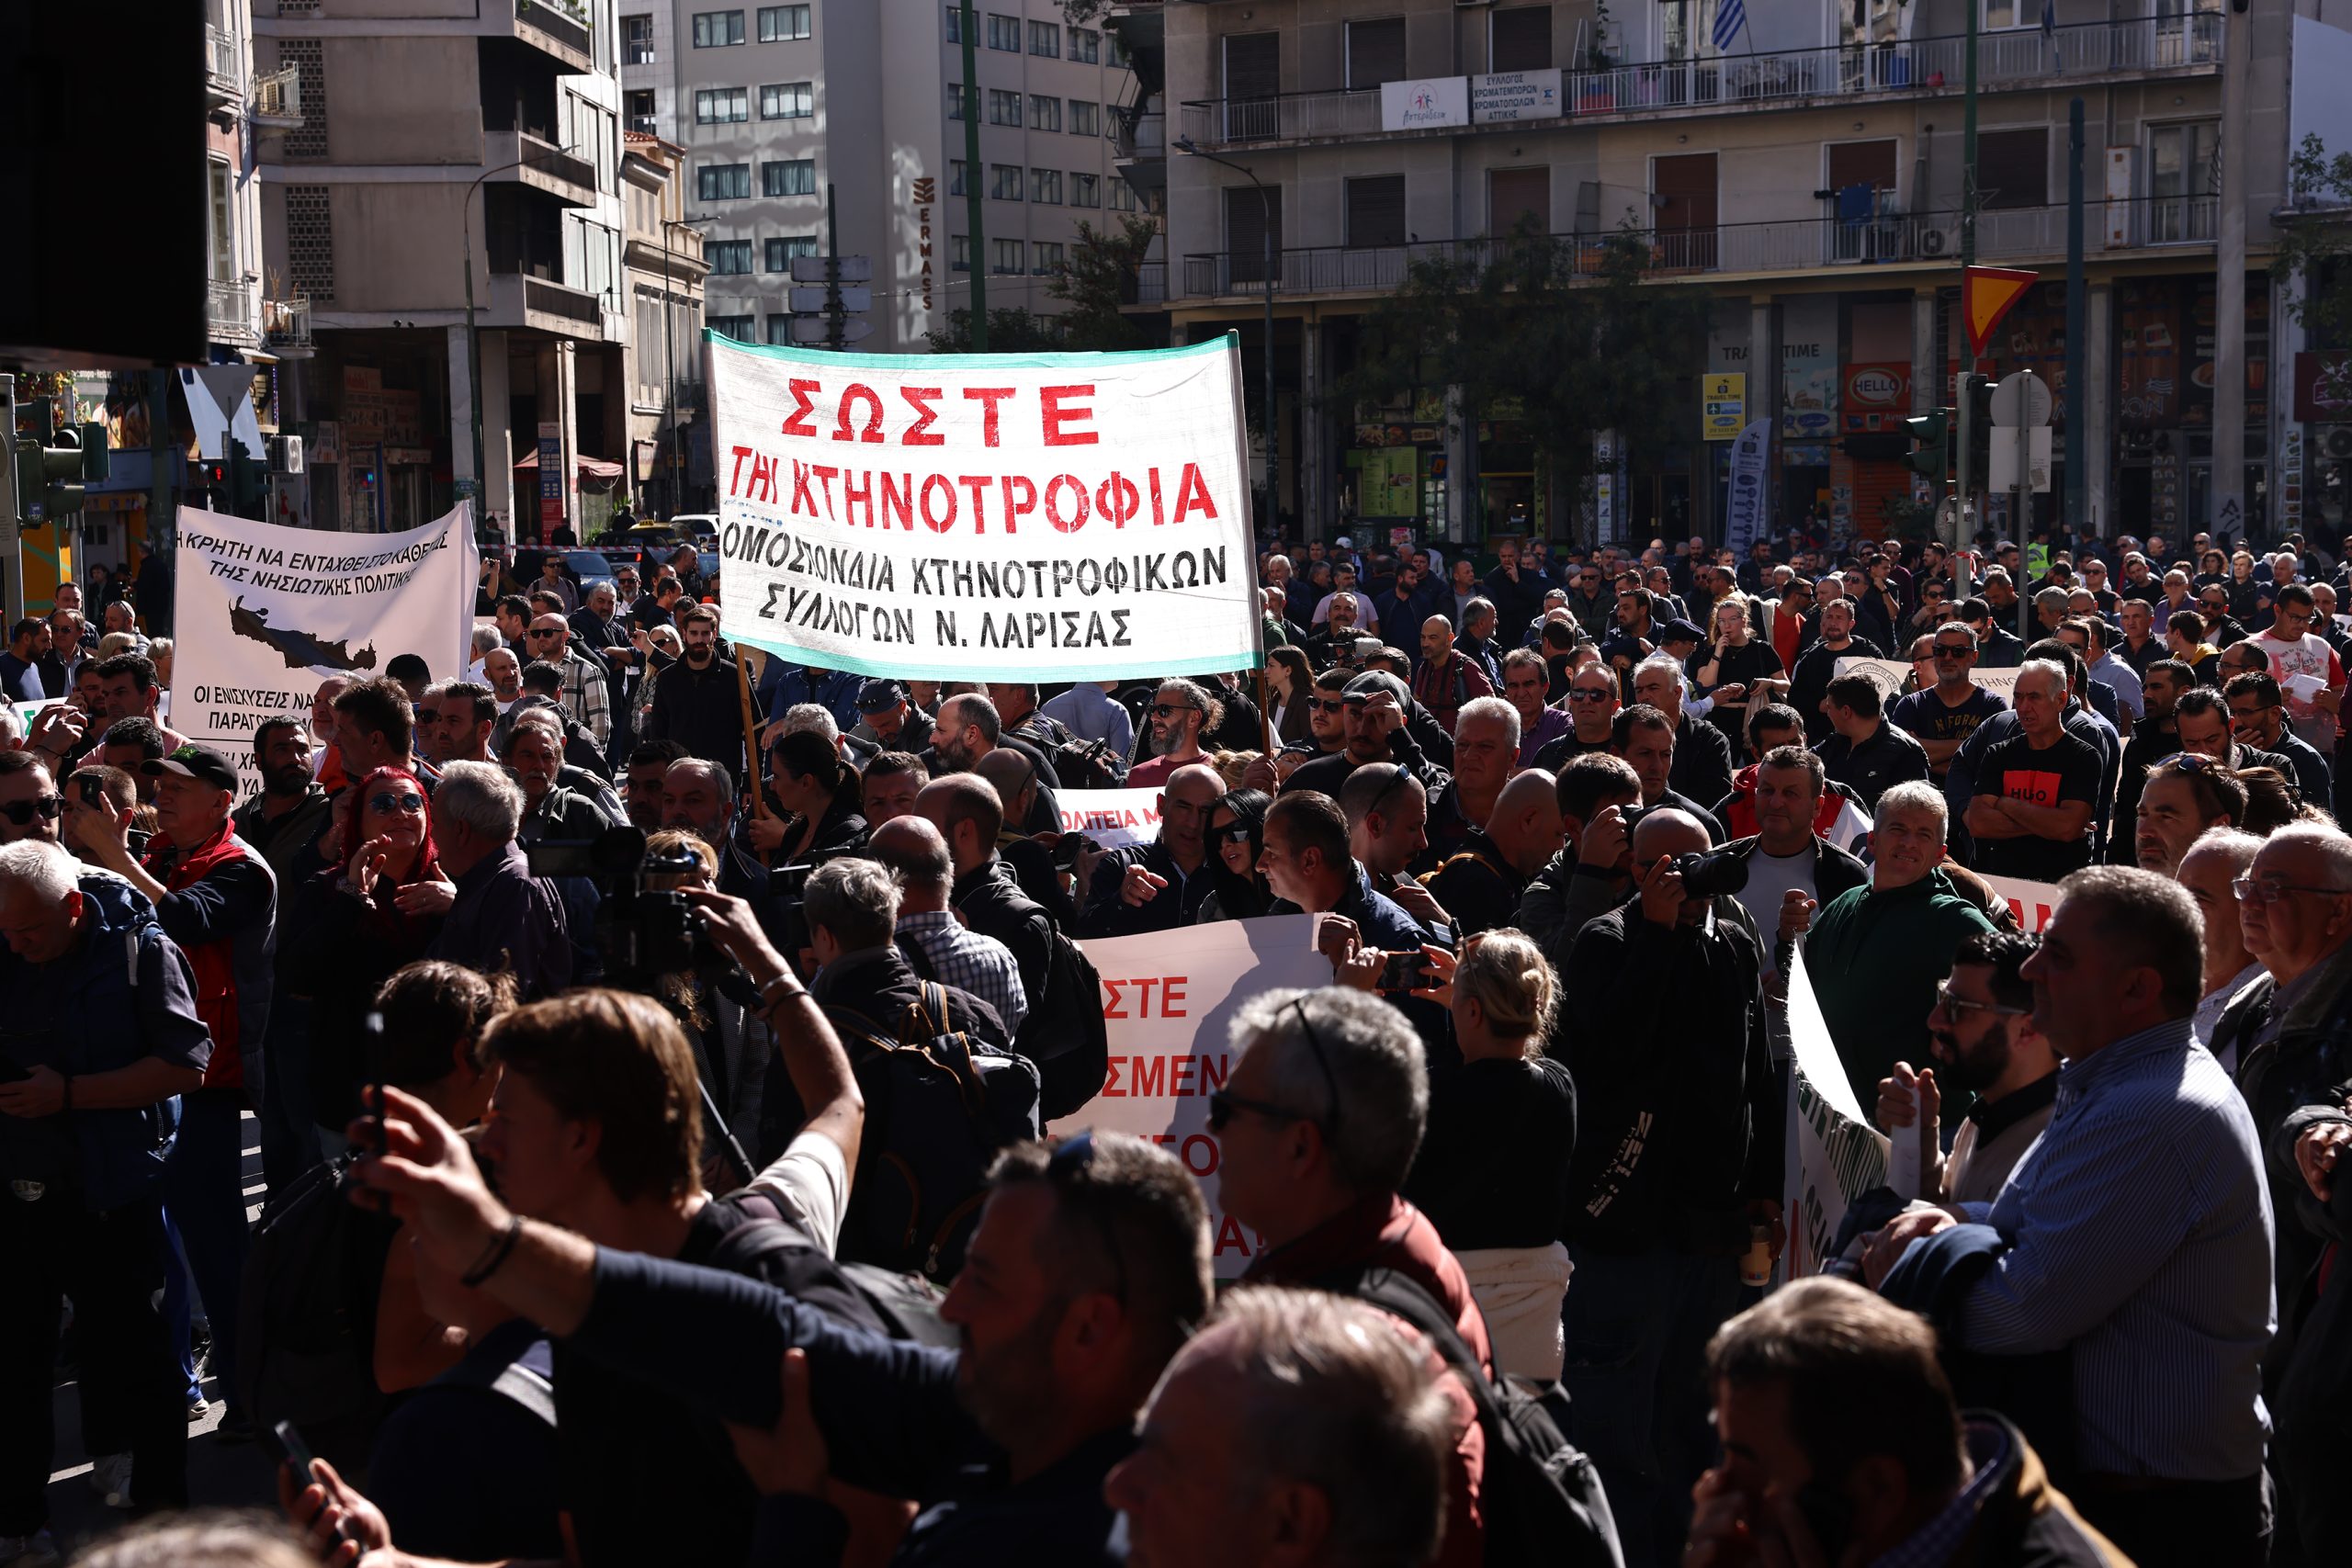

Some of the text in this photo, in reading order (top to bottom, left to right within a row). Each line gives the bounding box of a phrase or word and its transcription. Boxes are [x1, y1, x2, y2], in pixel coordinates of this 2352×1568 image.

[1487, 74, 1523, 87] ΣΥΛΛΟΓΟΣ
[1487, 109, 1518, 121] ΑΤΤΙΚΗΣ
[920, 208, 933, 310] ERMASS
[1782, 344, 1820, 358] TIME
[1855, 378, 1899, 393] HELLO
[782, 378, 1099, 447] ΣΩΣΤΕ
[791, 458, 1219, 535] ΚΤΗΝΟΤΡΟΦΙΑ
[187, 534, 254, 561] ΚΡΗΤΗ
[256, 547, 283, 568] ΝΑ
[288, 552, 368, 573] ΕΝΤΑΧΘΕΙ
[366, 551, 393, 569] ΣΤΟ
[723, 523, 1227, 600] ΟΜΟΣΠΟΝΔΙΑ ΚΤΗΝΟΤΡΟΦΙΚΩΝ
[209, 559, 251, 583] ΤΗΣ
[254, 570, 352, 596] ΝΗΣΙΩΤΙΚΗΣ
[759, 582, 1132, 649] ΣΥΛΛΟΓΩΝ Ν. ΛΑΡΙΣΑΣ
[194, 685, 315, 711] ΟΙ ΕΝΙΣΧΥΣΕΙΣ ΝΑ
[1971, 677, 2017, 687] ΤΗΝΟ
[1102, 976, 1188, 1019] ΣΤΕ
[1102, 1054, 1228, 1098] ΣΜΕΝ
